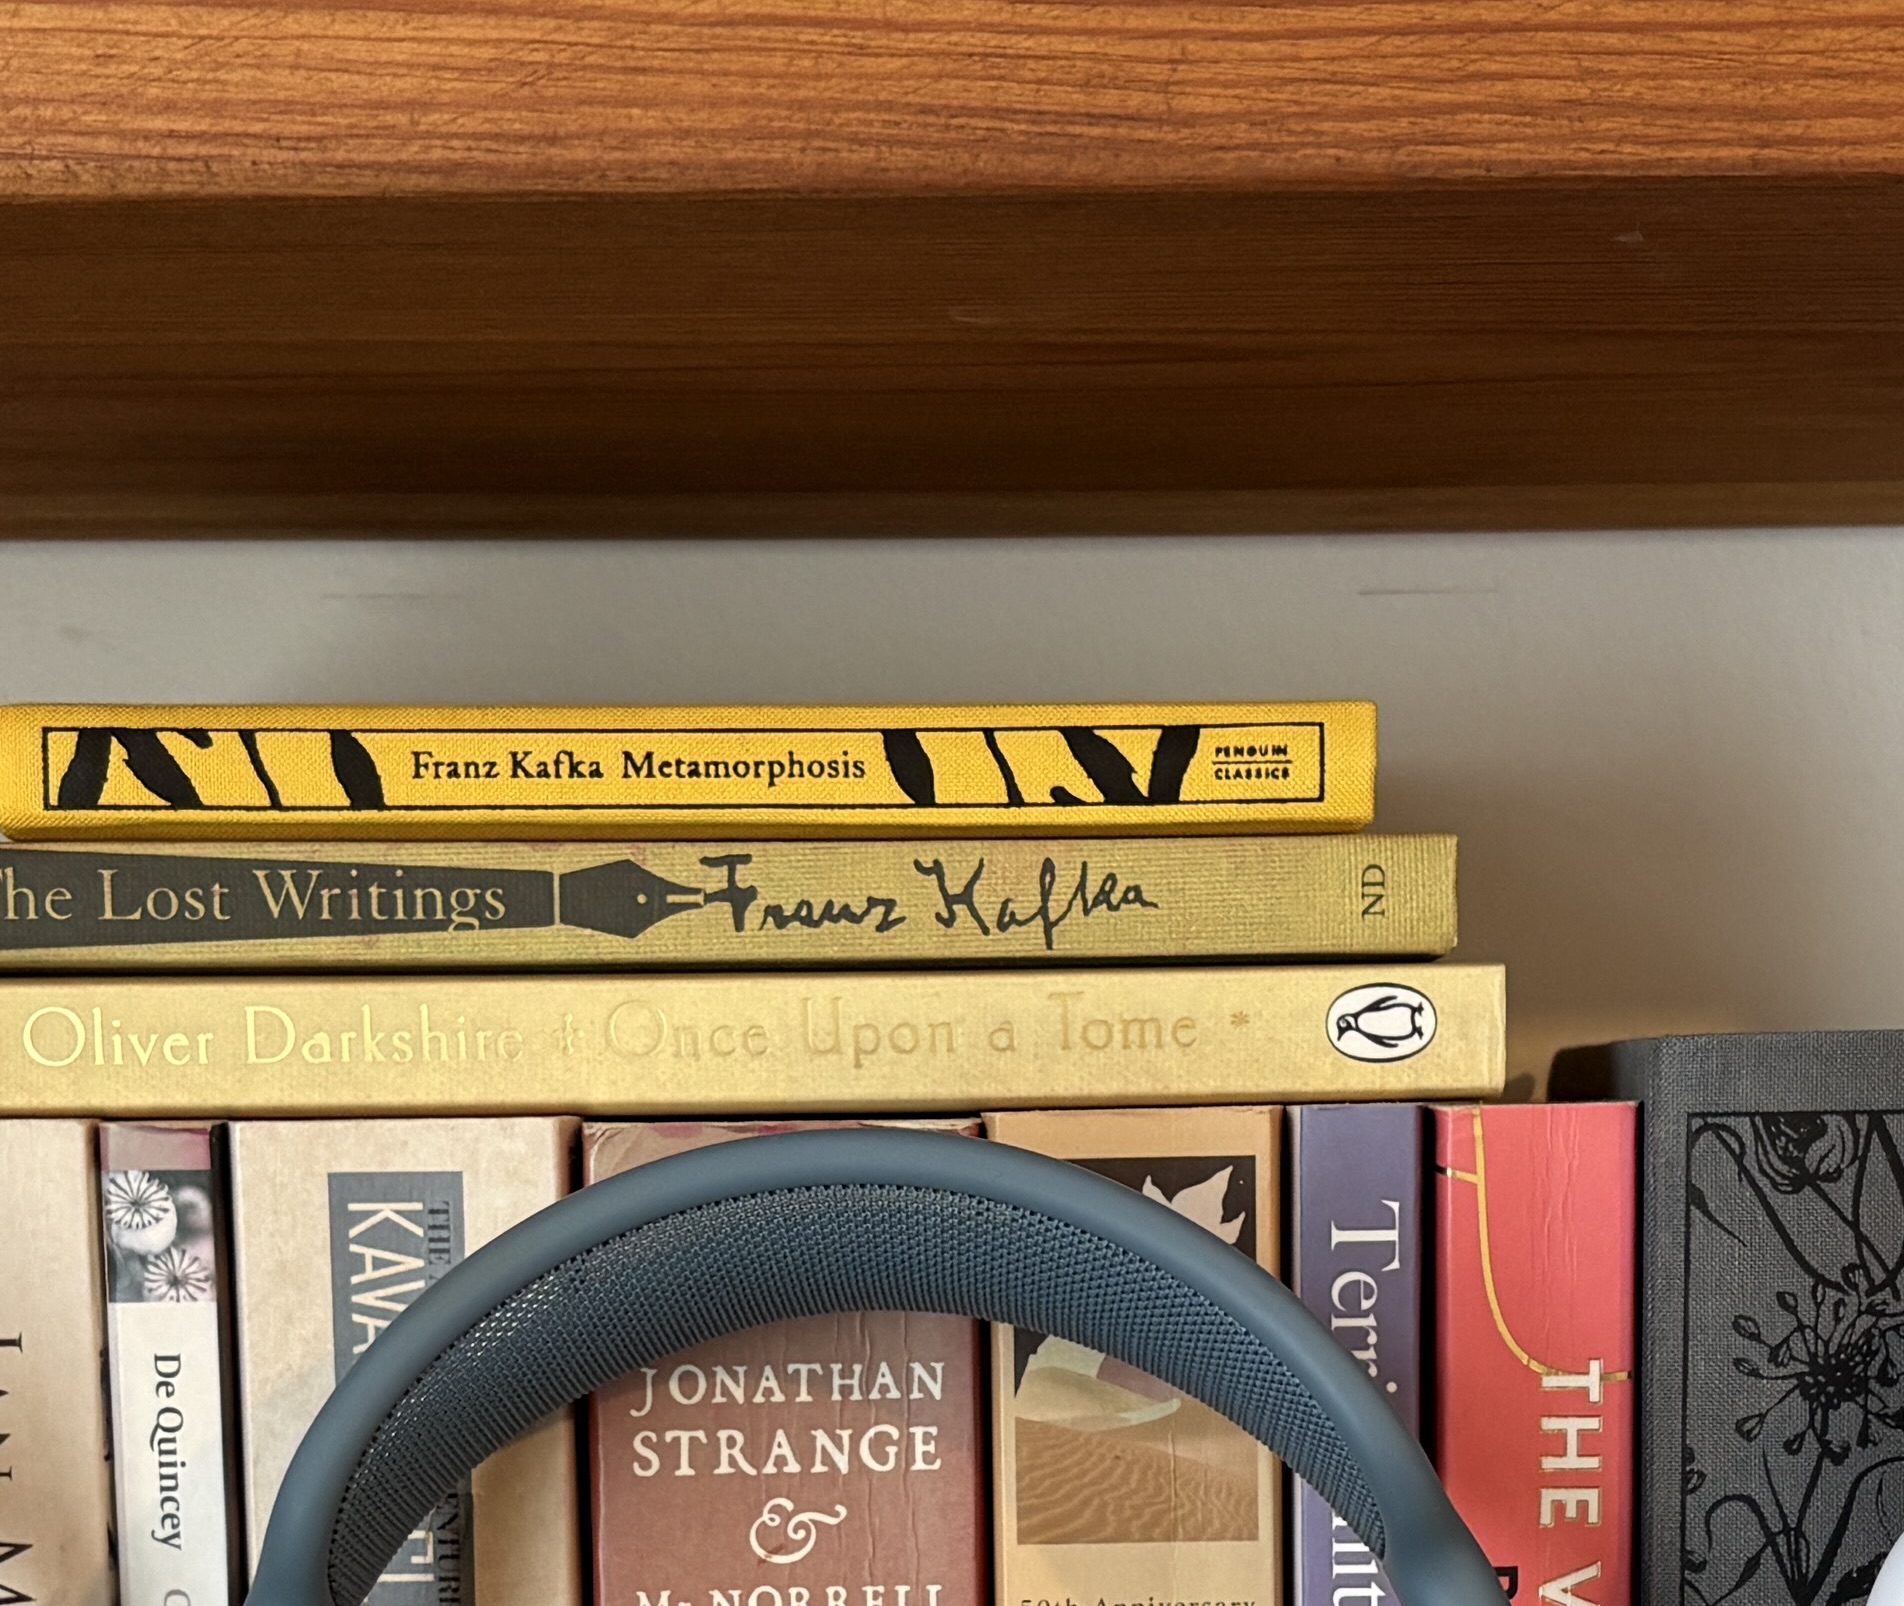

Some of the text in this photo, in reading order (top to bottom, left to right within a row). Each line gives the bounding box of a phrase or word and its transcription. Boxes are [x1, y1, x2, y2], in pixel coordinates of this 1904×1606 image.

[411, 749, 867, 789] Franz Kafka Metamorphosis
[1214, 767, 1291, 780] CLASSICS
[97, 868, 232, 922] Lost
[252, 867, 508, 933] Writings
[1362, 862, 1390, 919] ND
[22, 991, 1200, 1069] Oliver Darkshire Once Upon a Tome
[1330, 1199, 1402, 1391] Terr
[151, 1352, 183, 1398] De
[630, 1360, 947, 1418] JONATHAN
[631, 1423, 944, 1478] STRANGE
[1538, 1359, 1603, 1529] THE
[150, 1405, 185, 1552] Quincey
[749, 1497, 848, 1566] &
